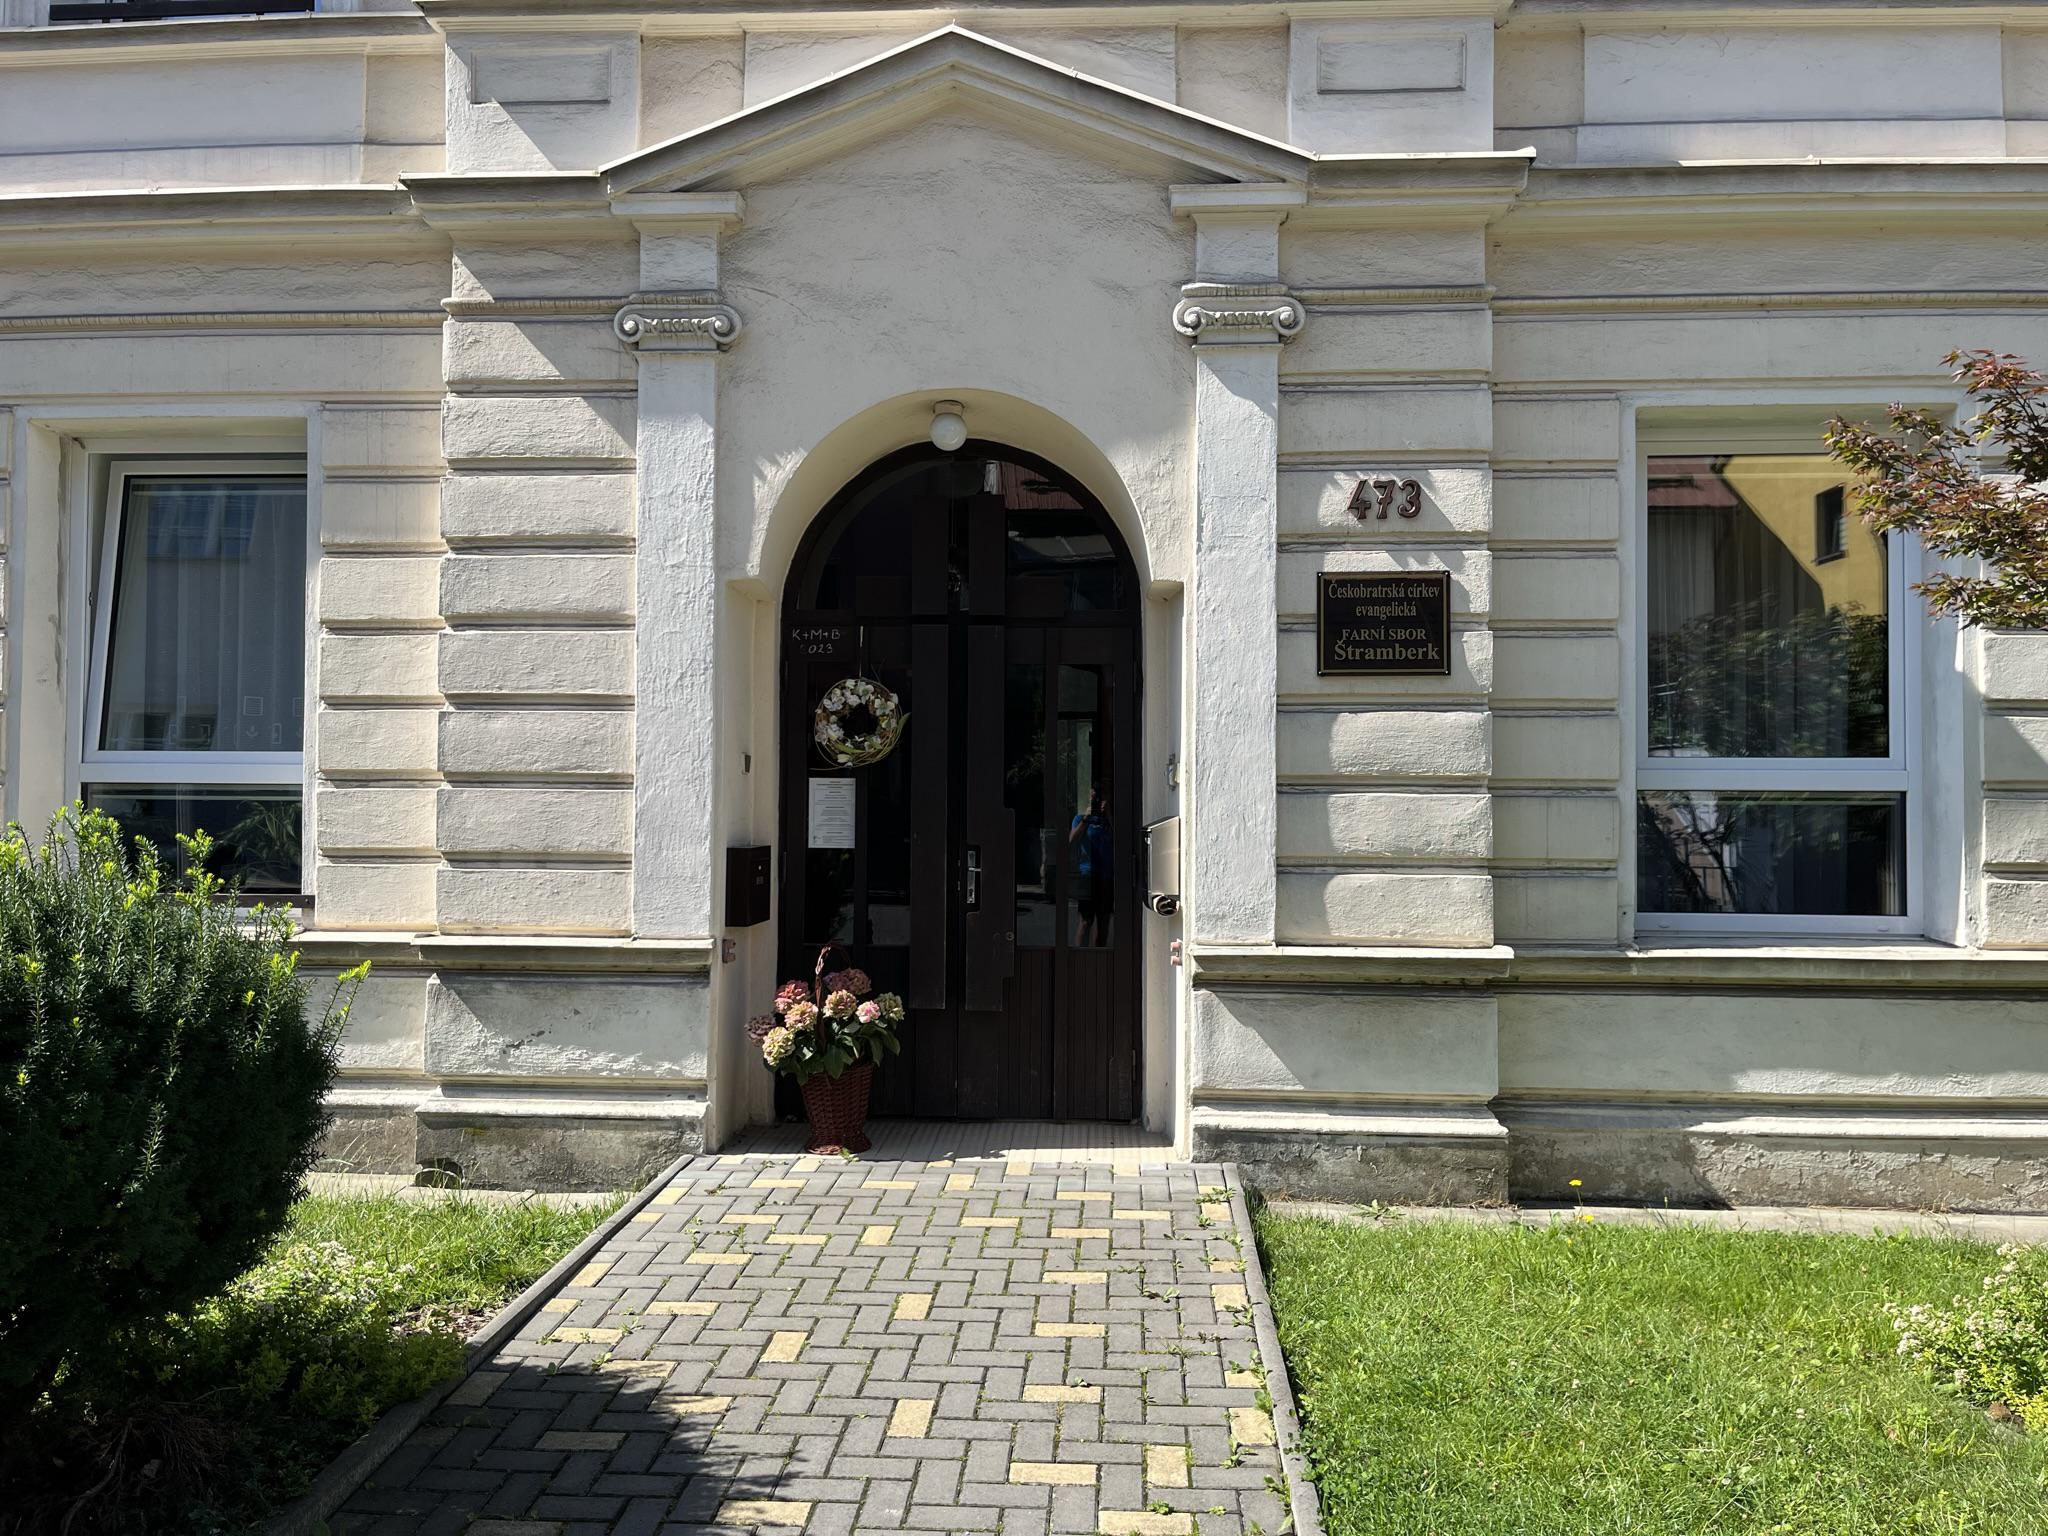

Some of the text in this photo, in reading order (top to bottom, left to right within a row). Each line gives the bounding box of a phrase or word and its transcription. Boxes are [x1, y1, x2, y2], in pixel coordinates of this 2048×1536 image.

[1348, 479, 1422, 519] 473
[1328, 579, 1440, 598] Českobratrská církev
[1356, 601, 1417, 620] evangelická
[1342, 626, 1427, 640] FARNÍ SBOR
[1334, 640, 1440, 661] Štramberk
